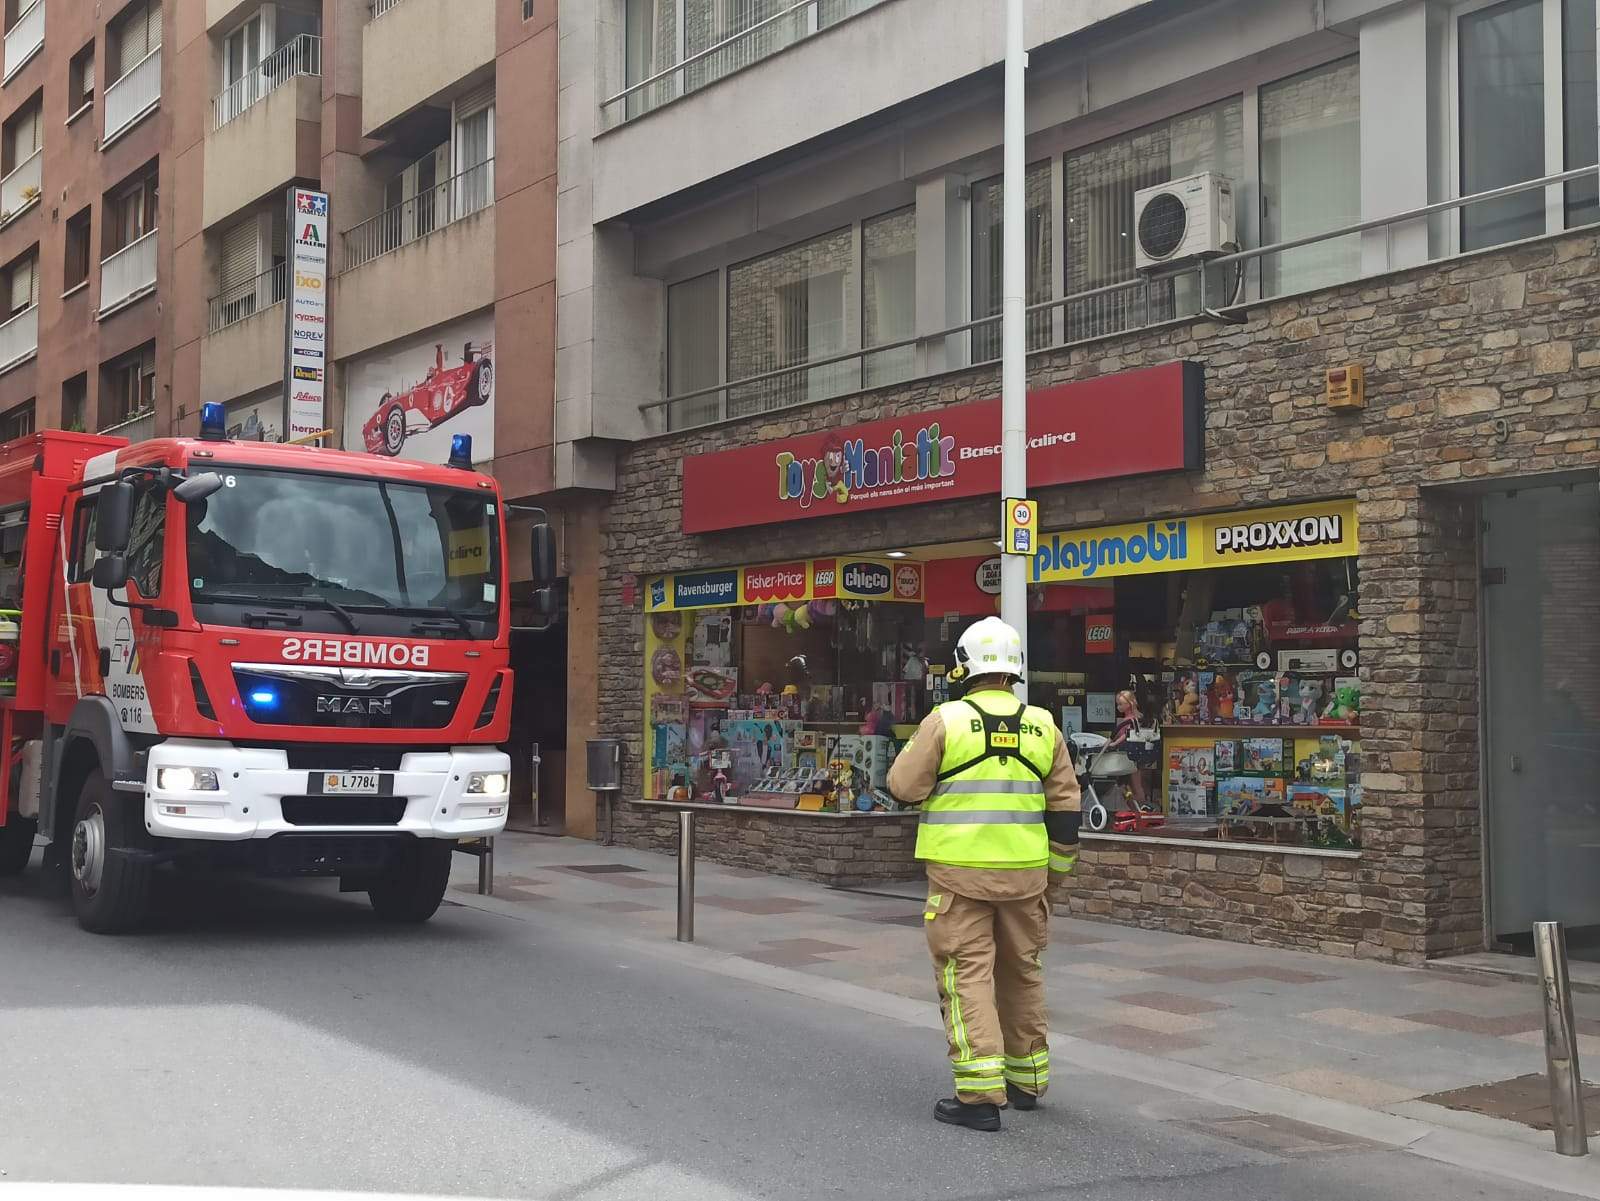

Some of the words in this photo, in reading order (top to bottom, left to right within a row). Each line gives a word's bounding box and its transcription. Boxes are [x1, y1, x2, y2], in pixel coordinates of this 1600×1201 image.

[297, 206, 326, 217] TAMIYA
[296, 239, 325, 248] ITALERI
[295, 313, 325, 324] KYOSHO
[294, 329, 324, 342] NOREV
[292, 423, 322, 436] herpa
[960, 445, 1004, 460] Basa
[776, 451, 829, 508] Toys
[843, 422, 956, 490] Maniatic
[925, 480, 954, 490] important
[1016, 510, 1028, 519] 30
[1215, 514, 1343, 555] PROXXON
[1032, 520, 1188, 582] playmobil
[746, 571, 804, 590] Fisher-Price
[815, 570, 835, 587] LEGO
[845, 567, 889, 590] chicco
[678, 581, 734, 597] Ravensburger
[1087, 626, 1111, 641] LEGO
[112, 683, 145, 700] BOMBERS
[316, 696, 392, 715] MAN
[129, 707, 142, 723] 118
[970, 719, 1043, 738] Bers
[350, 775, 375, 788] 7784
